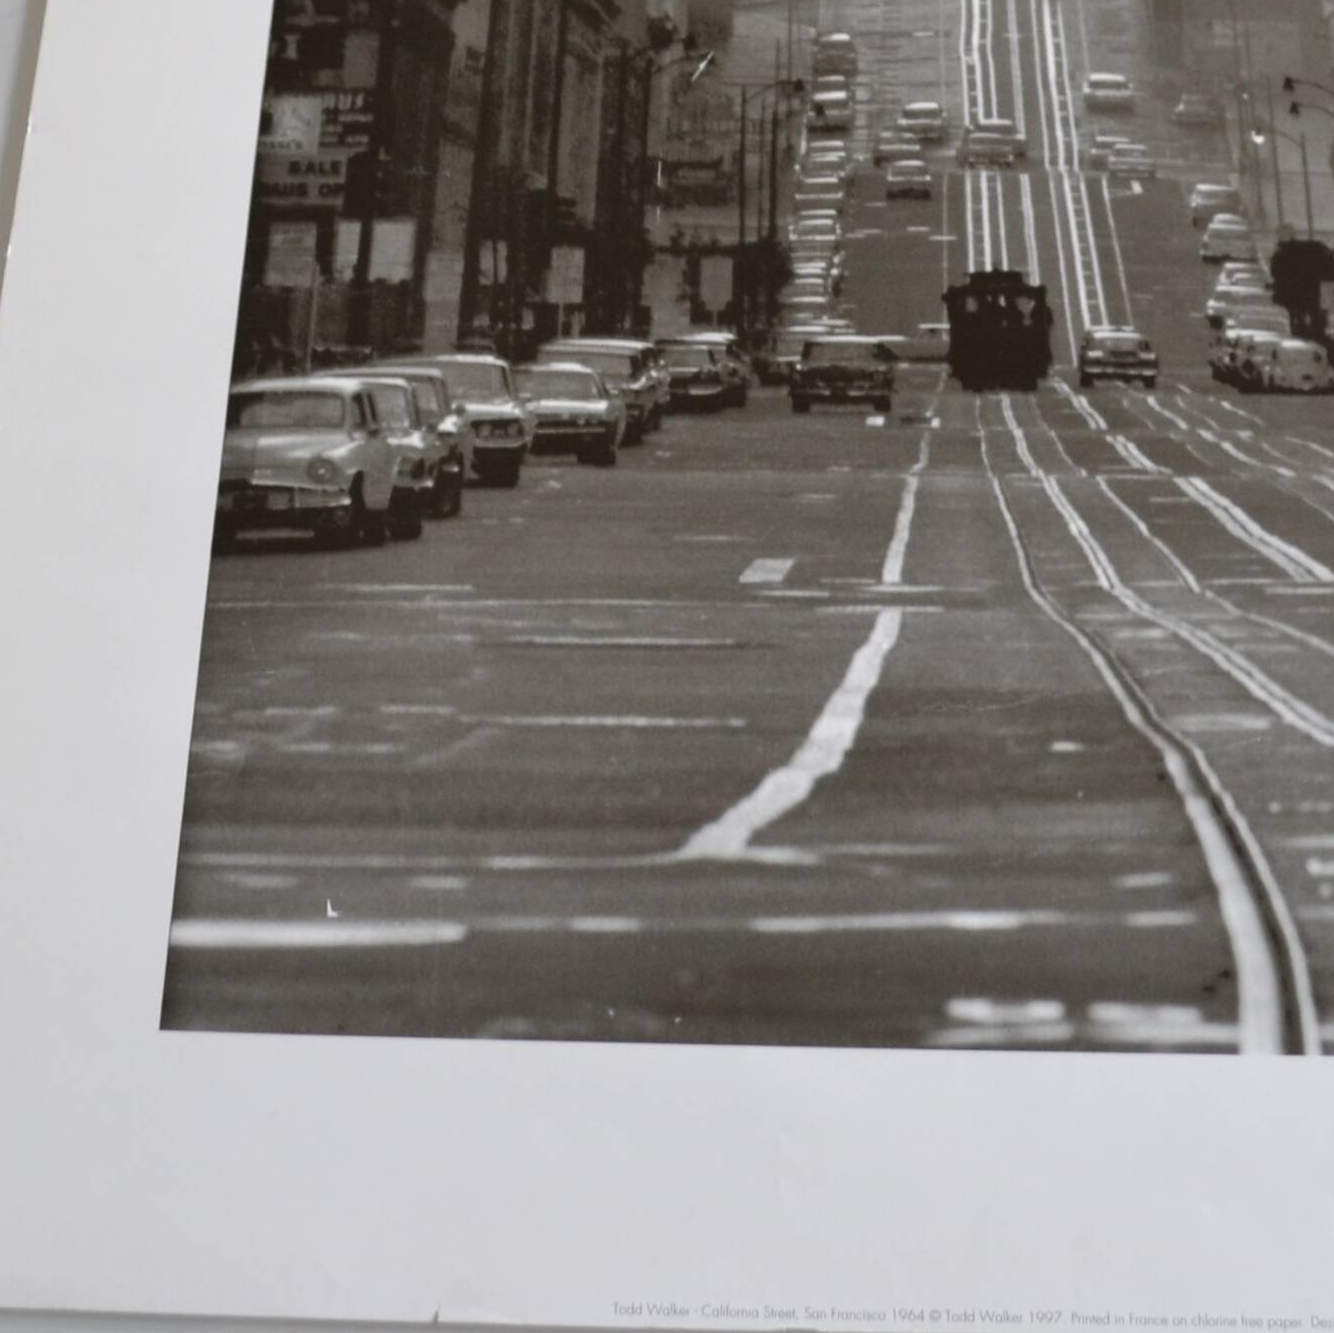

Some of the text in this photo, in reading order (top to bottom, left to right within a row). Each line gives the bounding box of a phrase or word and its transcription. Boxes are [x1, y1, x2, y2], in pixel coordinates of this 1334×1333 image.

[612, 1301, 643, 1316] Todd
[646, 1302, 690, 1317] Walker
[701, 1303, 759, 1319] California
[763, 1304, 799, 1321] Street,
[804, 1306, 827, 1321] San
[831, 1306, 886, 1322] Francisco
[892, 1308, 925, 1322] 1964
[945, 1308, 975, 1323] Todd
[979, 1309, 1023, 1324] Walker
[1071, 1310, 1110, 1325] Printed
[1114, 1312, 1125, 1325] in
[1128, 1311, 1168, 1326] France
[1171, 1315, 1188, 1327] on
[1191, 1312, 1237, 1327] chlorine
[1241, 1312, 1264, 1327] free
